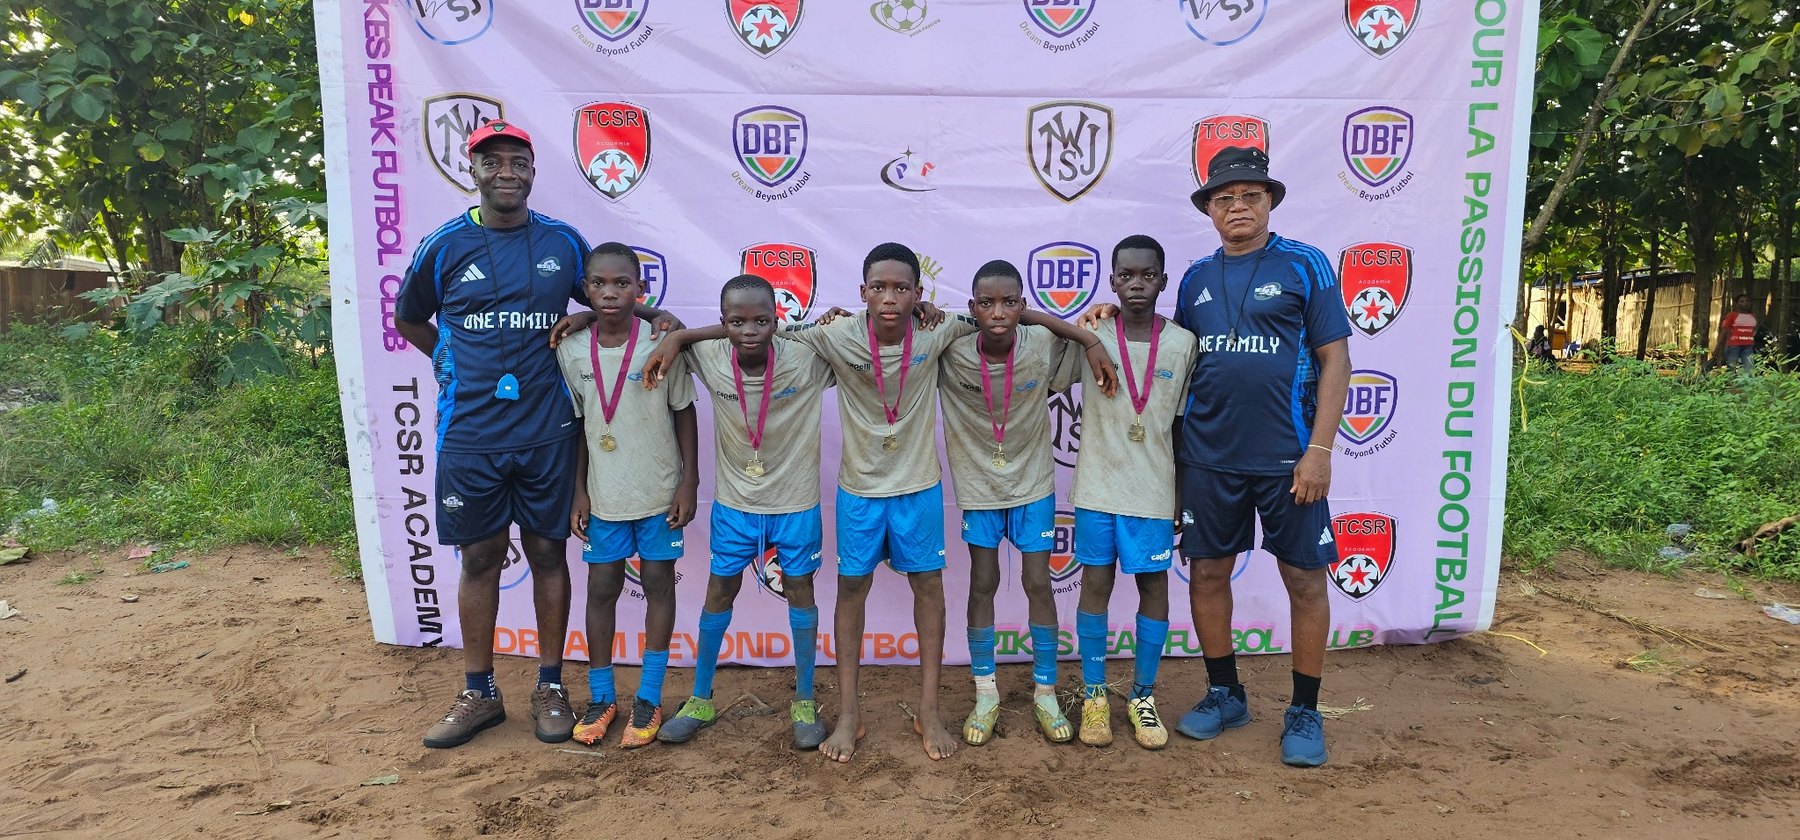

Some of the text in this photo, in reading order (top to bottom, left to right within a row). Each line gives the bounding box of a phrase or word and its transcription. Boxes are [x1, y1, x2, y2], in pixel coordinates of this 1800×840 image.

[571, 24, 654, 57] Dream Beyond Futbol
[1019, 21, 1100, 53] Dream Beyond Futbol
[583, 110, 640, 127] TCSR
[1203, 122, 1259, 139] TCSR
[742, 124, 800, 155] DBF
[1351, 125, 1407, 155] DBF
[364, 0, 408, 352] KES PEAK FUTBOL CLUB
[731, 170, 811, 202] Dream Beyond Futbol
[1338, 171, 1414, 202] Dream Beyond Futbol
[750, 250, 806, 267] TCSR
[1349, 250, 1402, 266] TCSR
[1037, 259, 1093, 288] DBF
[464, 312, 559, 329] ONE FAMILY
[1424, 0, 1507, 640] OUR LA PASSION DU FOOTBALL
[1199, 335, 1280, 354] NE FAMILY
[1344, 429, 1398, 459] Beyond Futbol
[393, 377, 443, 648] TCSR ACADEMY
[1336, 519, 1387, 534] TCSR
[630, 590, 645, 600] Bey
[1053, 583, 1073, 594] yond
[494, 627, 626, 657] DRAM
[1165, 628, 1282, 654] FUBOL
